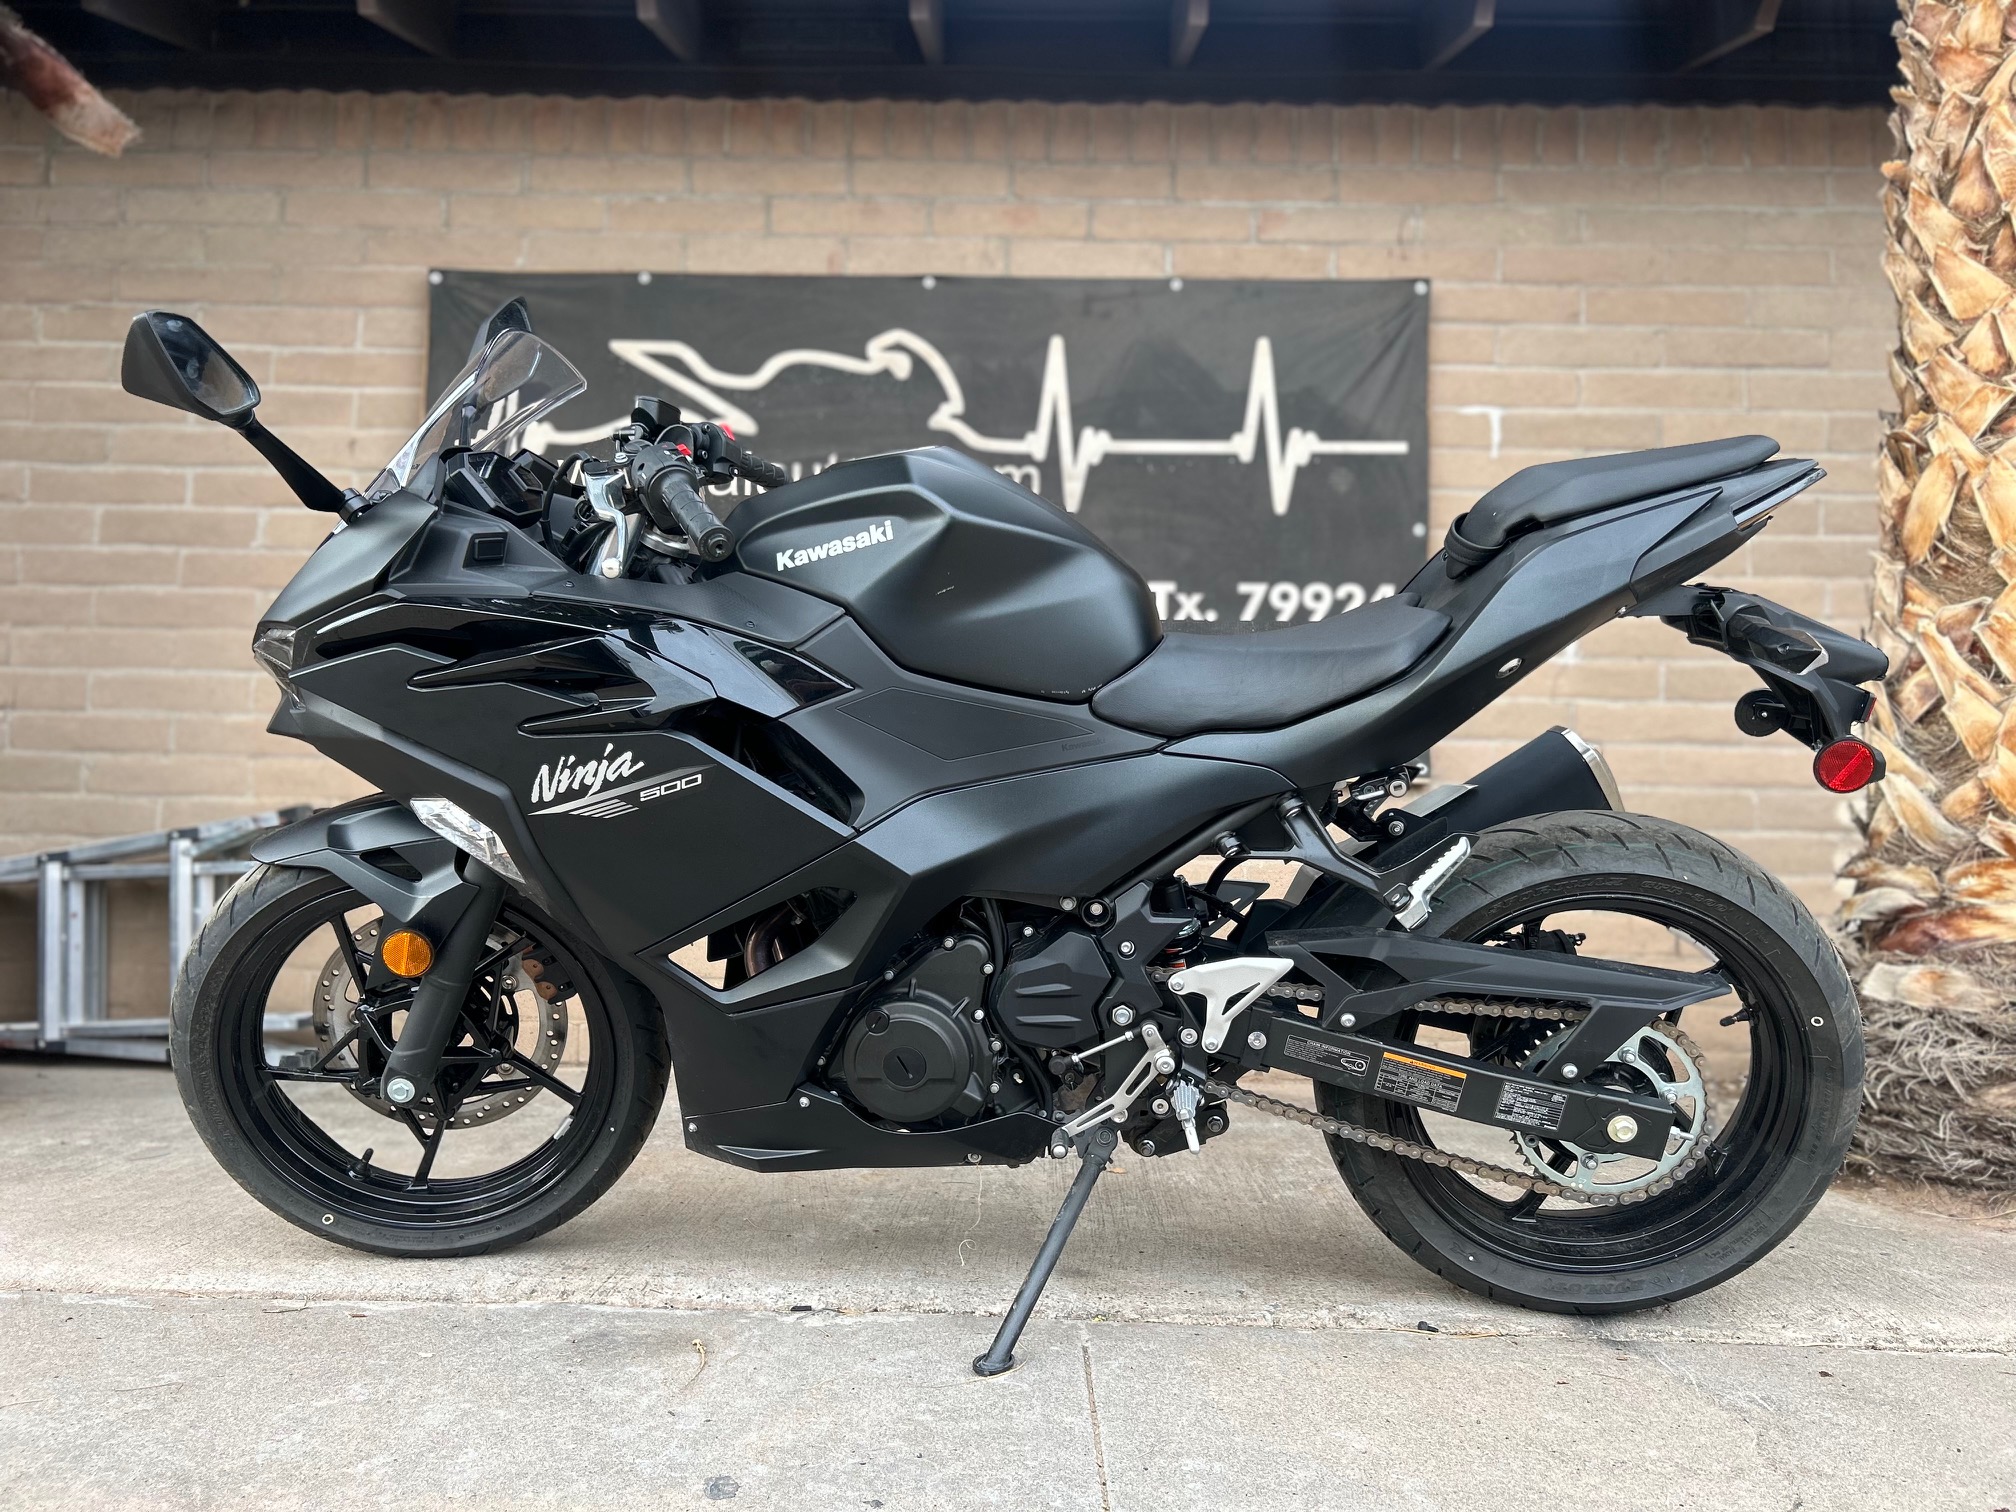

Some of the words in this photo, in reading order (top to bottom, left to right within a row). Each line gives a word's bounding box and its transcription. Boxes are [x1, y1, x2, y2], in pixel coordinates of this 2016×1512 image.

[776, 520, 894, 572] Kawasaki
[1148, 580, 1219, 623] Tx.
[1060, 737, 1107, 752] Kawasaki
[531, 743, 645, 803] Ninja
[640, 774, 702, 802] 500
